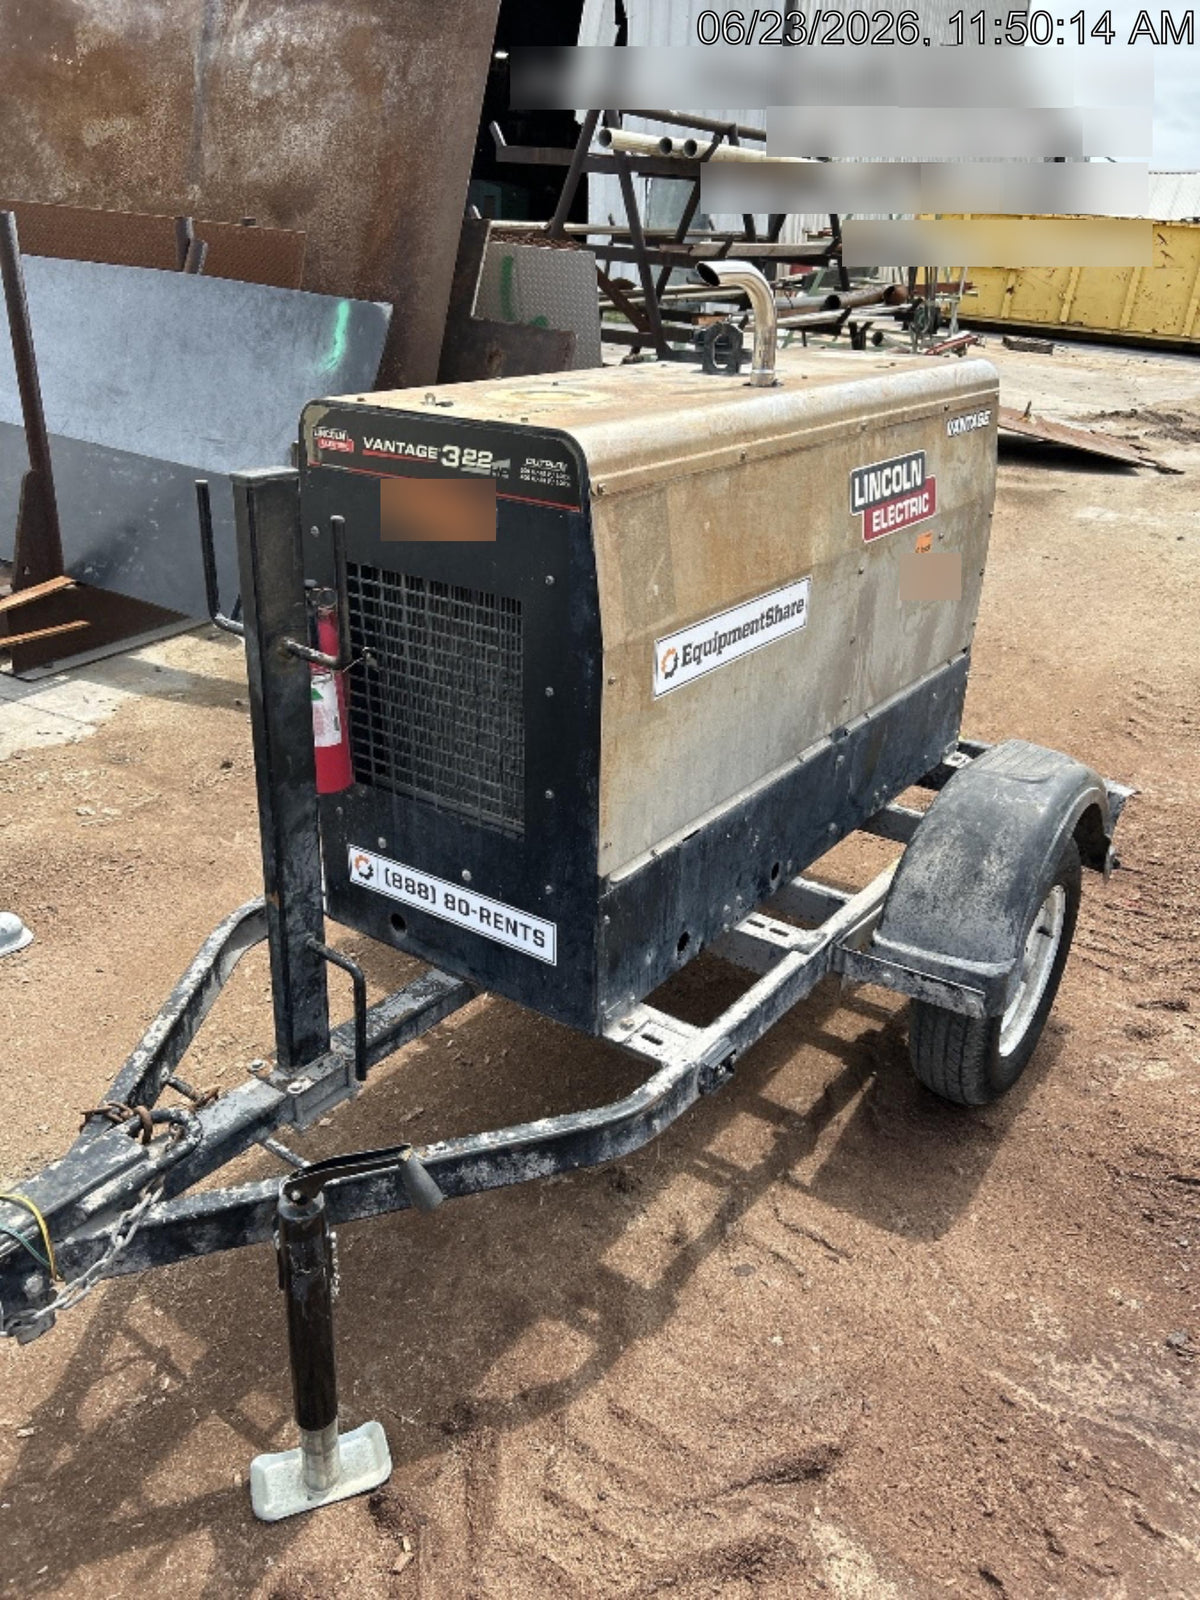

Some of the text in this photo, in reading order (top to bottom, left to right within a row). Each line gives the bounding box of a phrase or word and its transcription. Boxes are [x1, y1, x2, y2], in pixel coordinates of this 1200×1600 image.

[946, 410, 992, 437] VANTAGE
[362, 437, 438, 460] VANTAGE
[441, 444, 494, 469] 322
[854, 458, 922, 507] LINCOLN
[872, 492, 929, 532] ELECTRIC
[680, 598, 805, 668] EquipmentShare
[384, 867, 545, 949] (888) 80-RENTS
